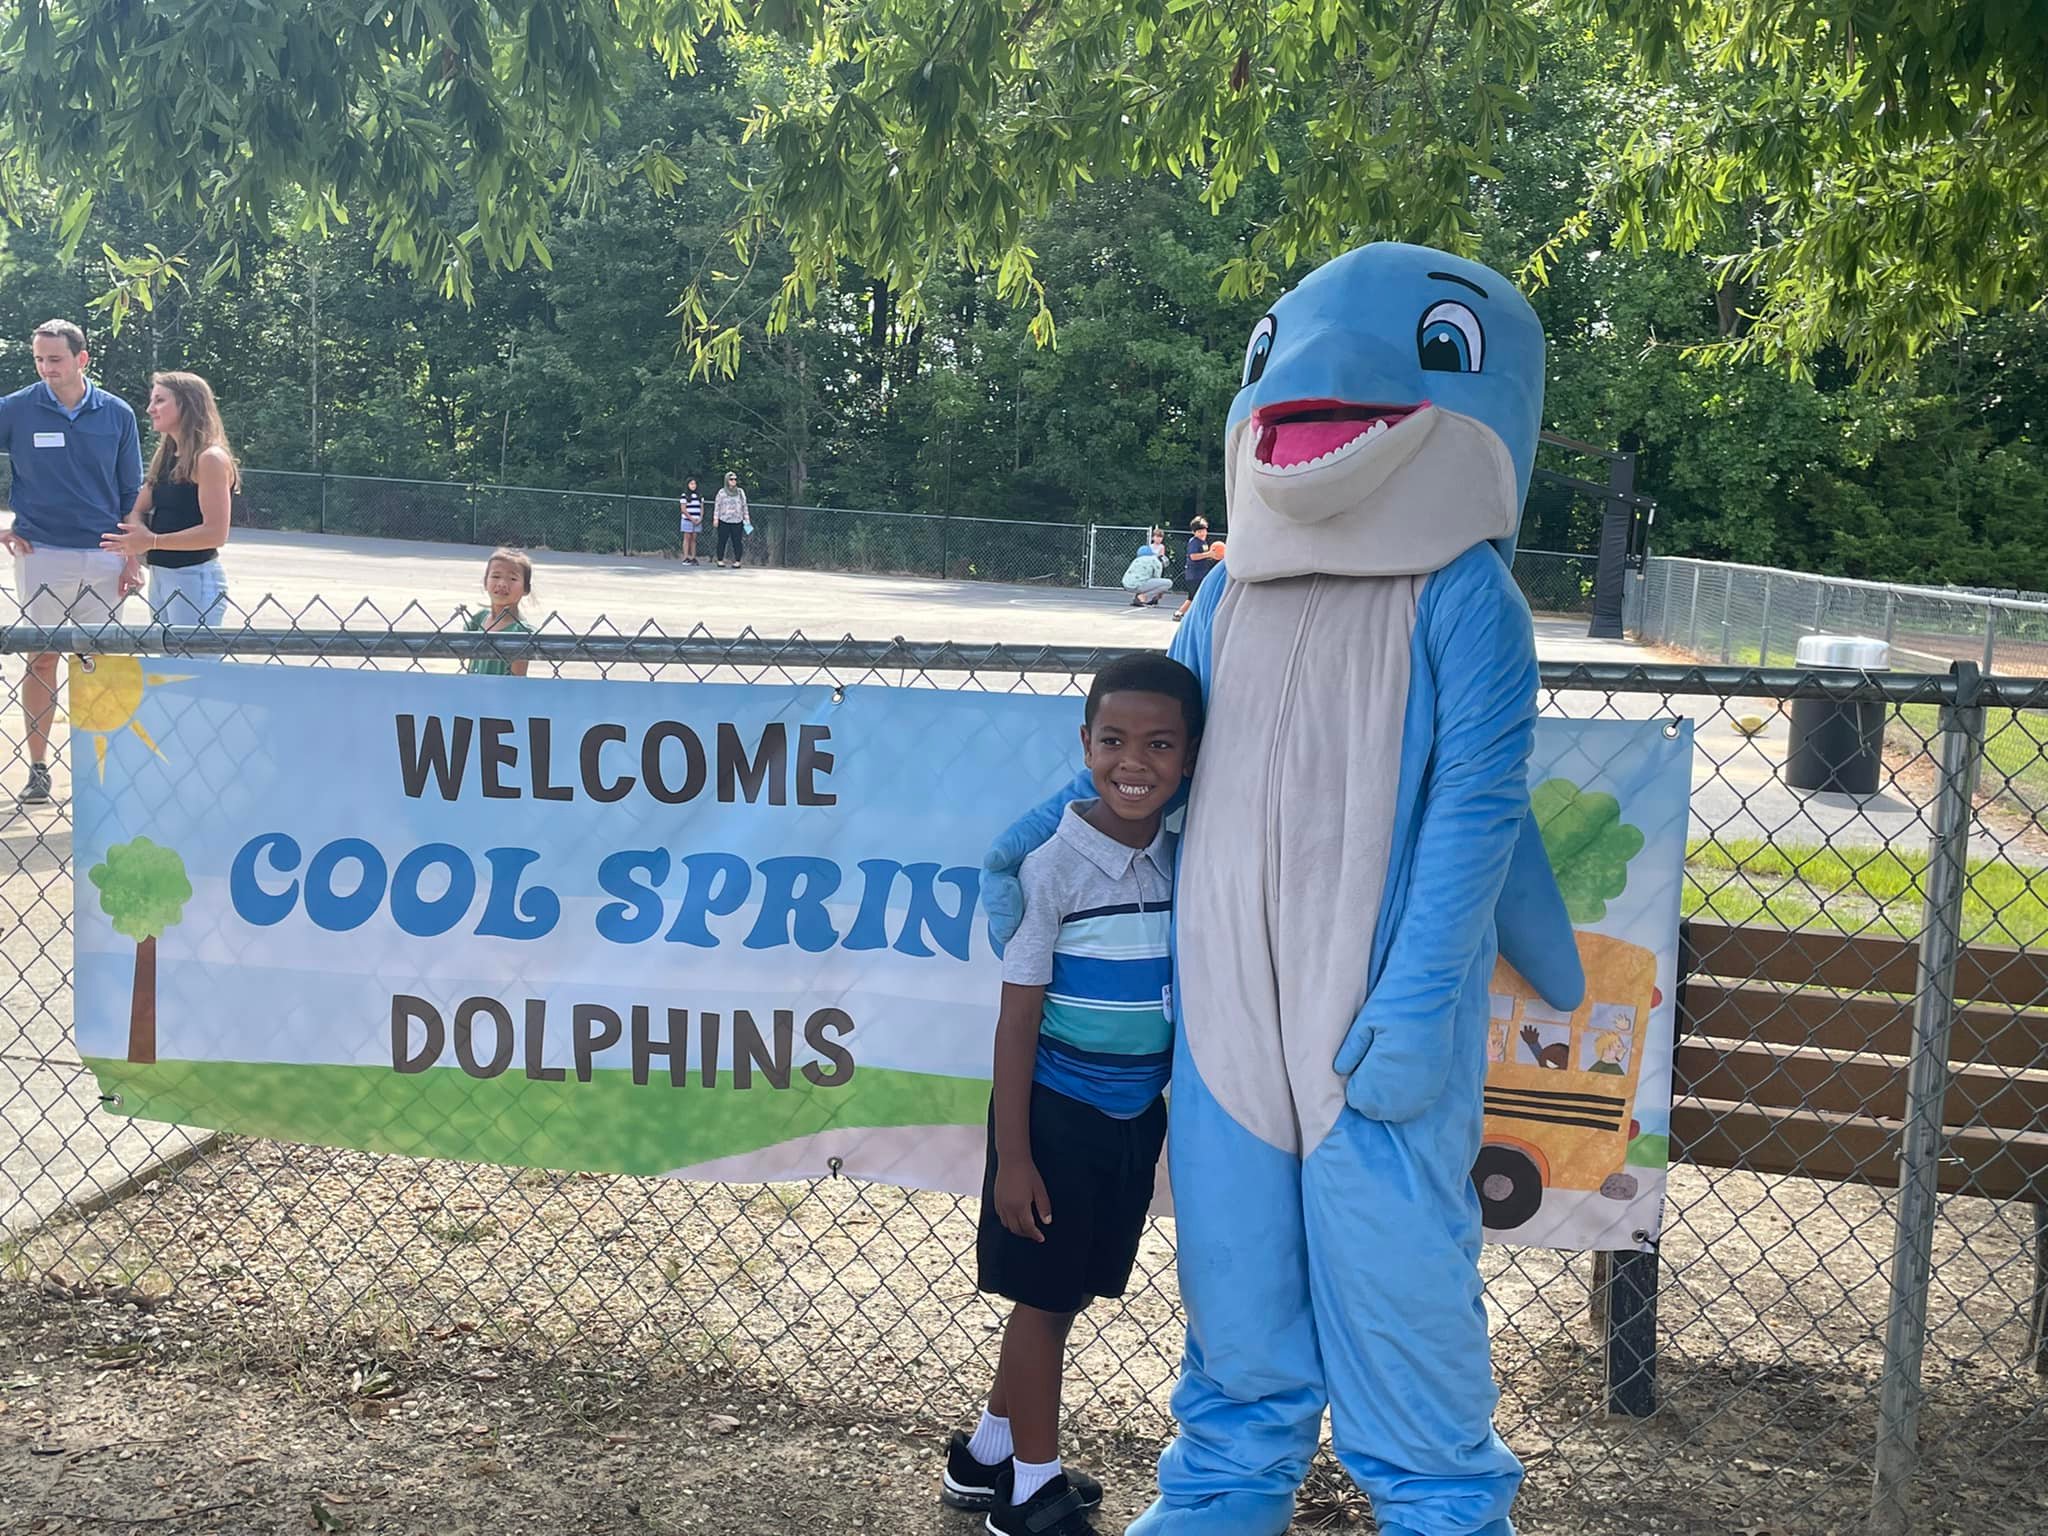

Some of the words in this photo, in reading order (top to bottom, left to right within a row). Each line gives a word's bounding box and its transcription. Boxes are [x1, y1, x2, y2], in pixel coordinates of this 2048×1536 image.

[396, 714, 838, 808] WELCOME
[230, 832, 561, 941] COOL
[595, 846, 1004, 962] SPRIN
[391, 994, 855, 1090] DOLPHINS
